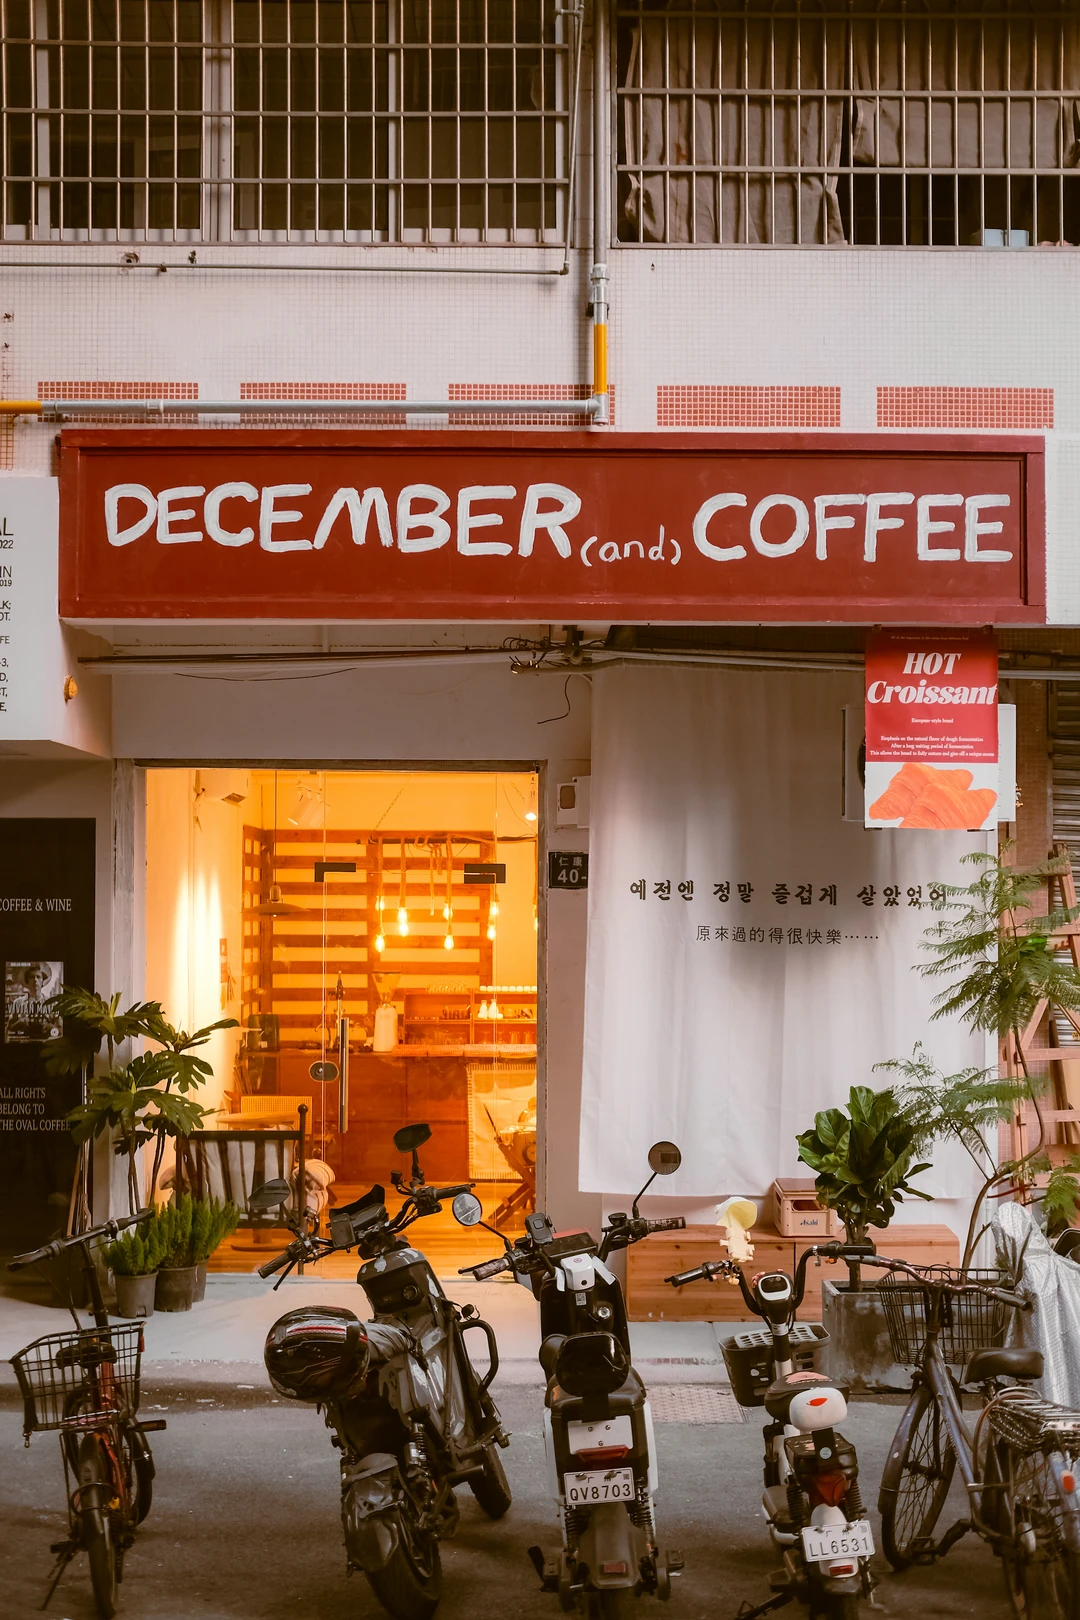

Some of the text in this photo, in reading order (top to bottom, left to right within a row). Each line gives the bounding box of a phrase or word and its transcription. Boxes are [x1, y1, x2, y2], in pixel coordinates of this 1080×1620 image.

[104, 481, 1013, 567] DECEMBER (and) COFFEE
[902, 652, 961, 675] HOT
[867, 679, 997, 705] Croissant
[629, 878, 694, 902] 예전엔
[712, 880, 755, 904] 정말
[771, 883, 838, 906] 즐겁게
[35, 898, 43, 911] &
[45, 898, 72, 911] WINE
[15, 1087, 46, 1099] RIGHTS
[33, 1103, 45, 1115] TO
[15, 1119, 38, 1131] OVAL
[40, 1119, 70, 1131] COFFEE
[569, 1483, 631, 1502] QV8703
[809, 1537, 870, 1558] LL6531
